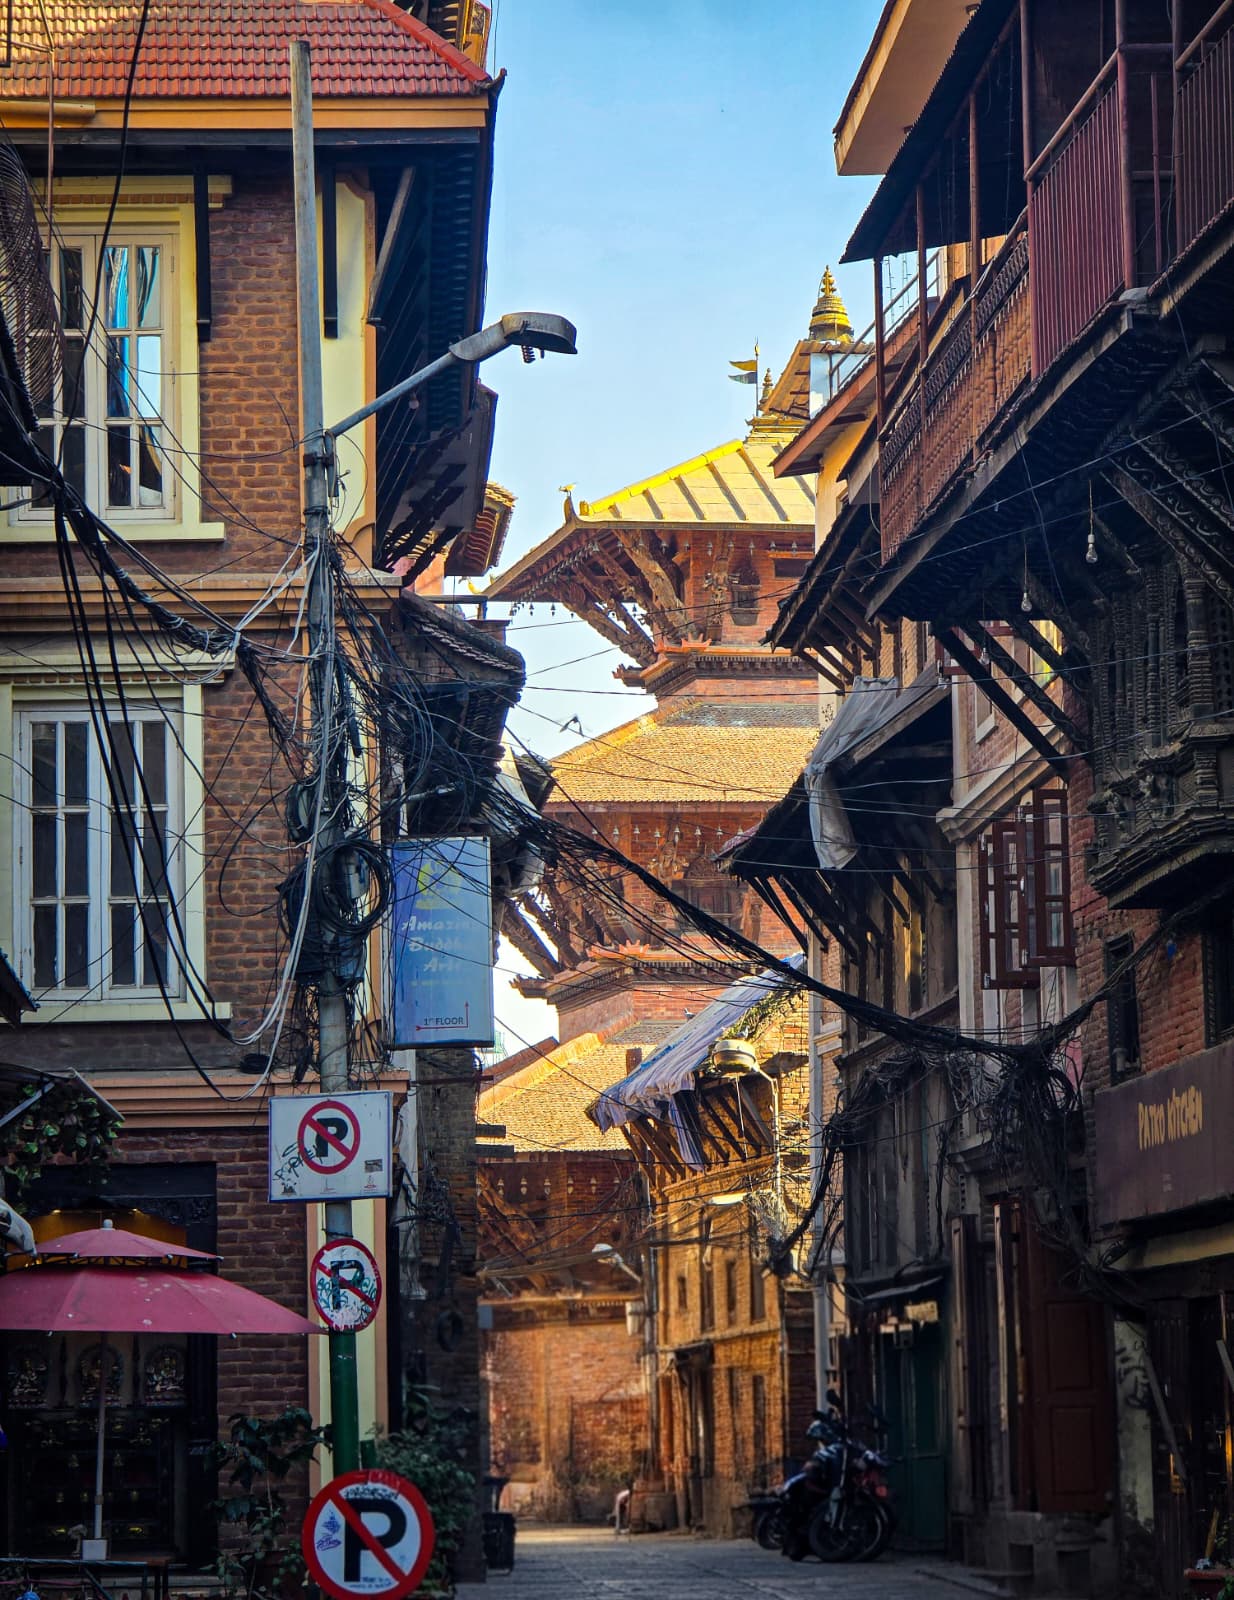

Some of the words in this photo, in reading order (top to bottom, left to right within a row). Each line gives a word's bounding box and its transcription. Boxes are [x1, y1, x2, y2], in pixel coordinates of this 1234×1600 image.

[402, 915, 474, 931] Amazin
[435, 1015, 464, 1025] FLOOR
[315, 1117, 348, 1157] P
[343, 1498, 407, 1582] P
